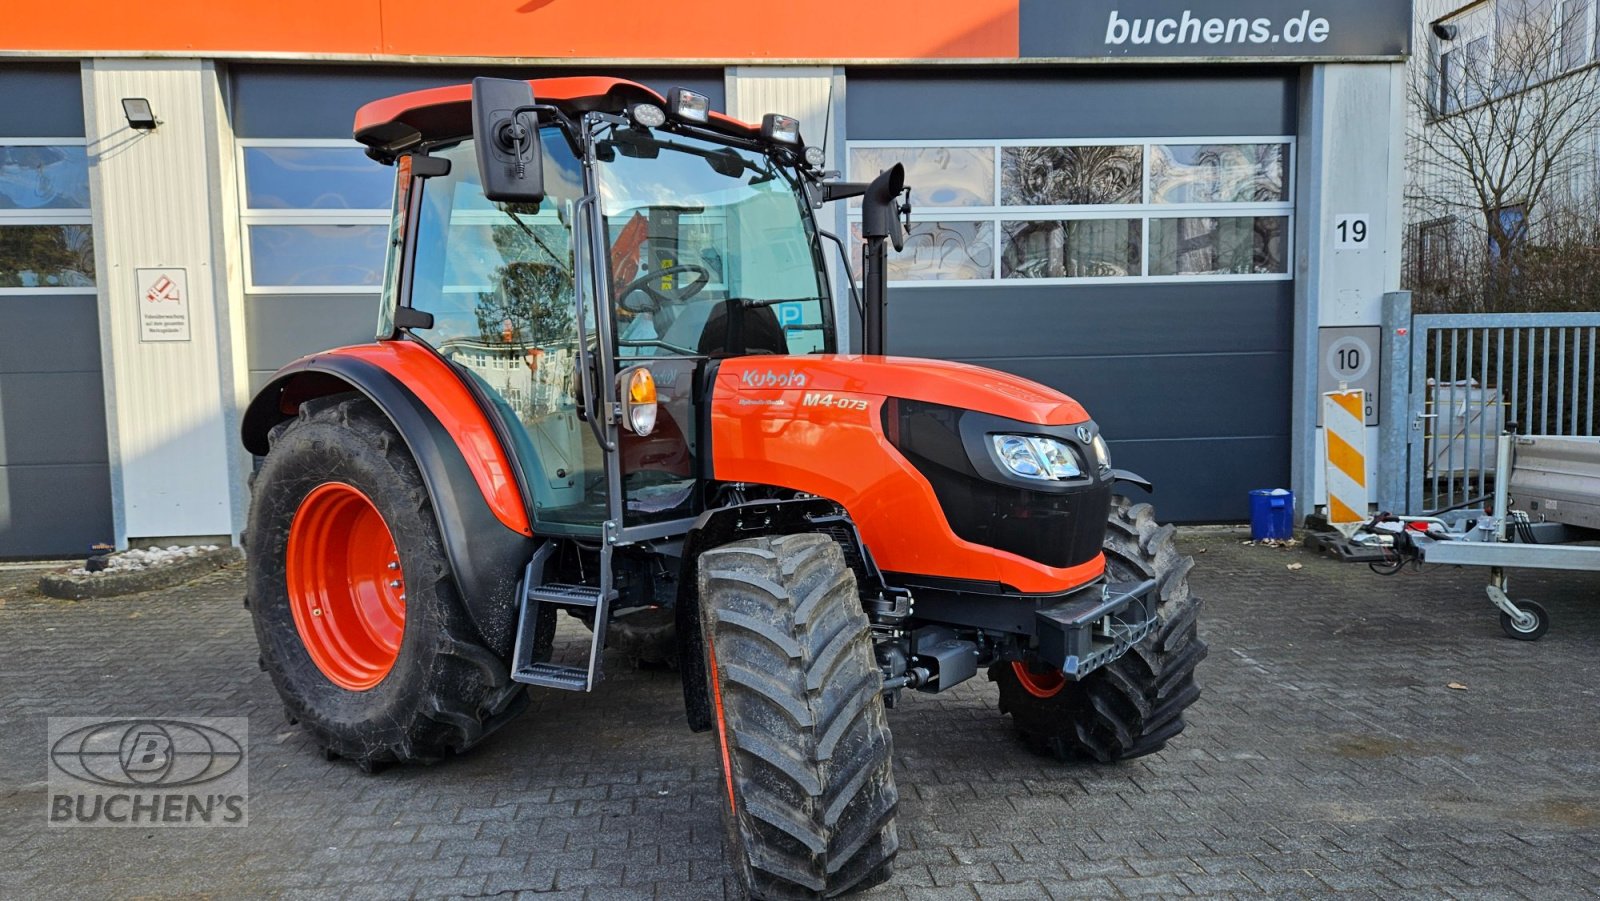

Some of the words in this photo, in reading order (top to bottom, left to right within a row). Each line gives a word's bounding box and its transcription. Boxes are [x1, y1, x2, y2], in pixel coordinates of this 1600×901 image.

[1104, 10, 1330, 44] buchens.de
[1336, 219, 1367, 243] 19
[1338, 349, 1360, 370] 10
[742, 369, 806, 387] Kubota
[802, 392, 868, 411] M4-073
